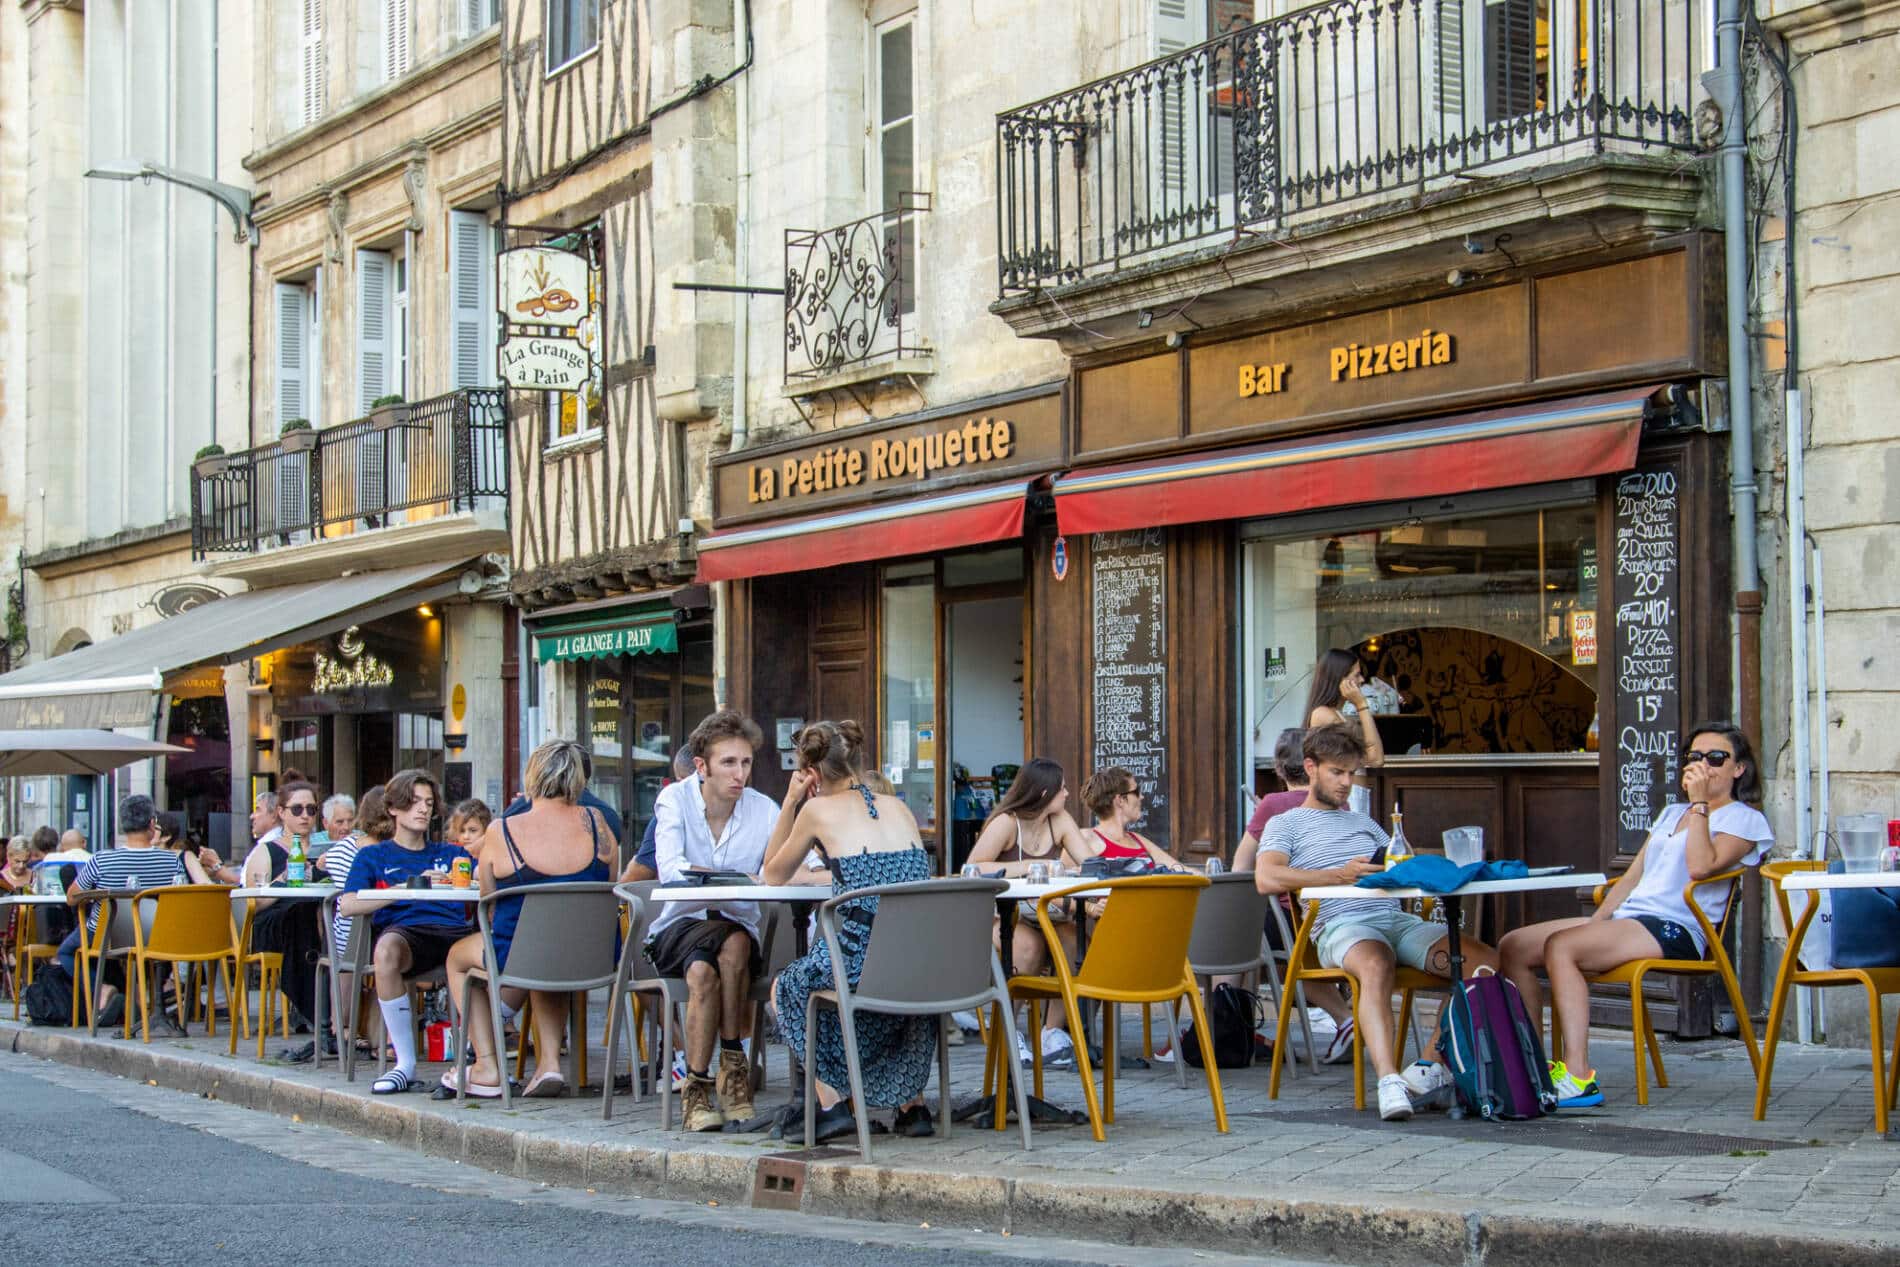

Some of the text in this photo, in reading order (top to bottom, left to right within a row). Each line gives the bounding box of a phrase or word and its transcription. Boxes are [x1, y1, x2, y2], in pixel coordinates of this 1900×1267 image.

[505, 340, 584, 368] La Grange
[1239, 328, 1450, 398] Bar Pizzeria
[519, 364, 569, 385] à Pain
[748, 416, 1010, 503] La Petite Roquette
[1644, 471, 1676, 497] DUO
[1619, 496, 1628, 516] 2
[1618, 538, 1628, 558] 2
[1642, 597, 1669, 626] MIDI
[556, 628, 652, 656] LA GRANGE A PAIN
[1628, 625, 1670, 645] PIZZA
[1623, 656, 1672, 675] DESSERT
[595, 680, 621, 693] NOUGAT
[1621, 726, 1675, 758] SALADE
